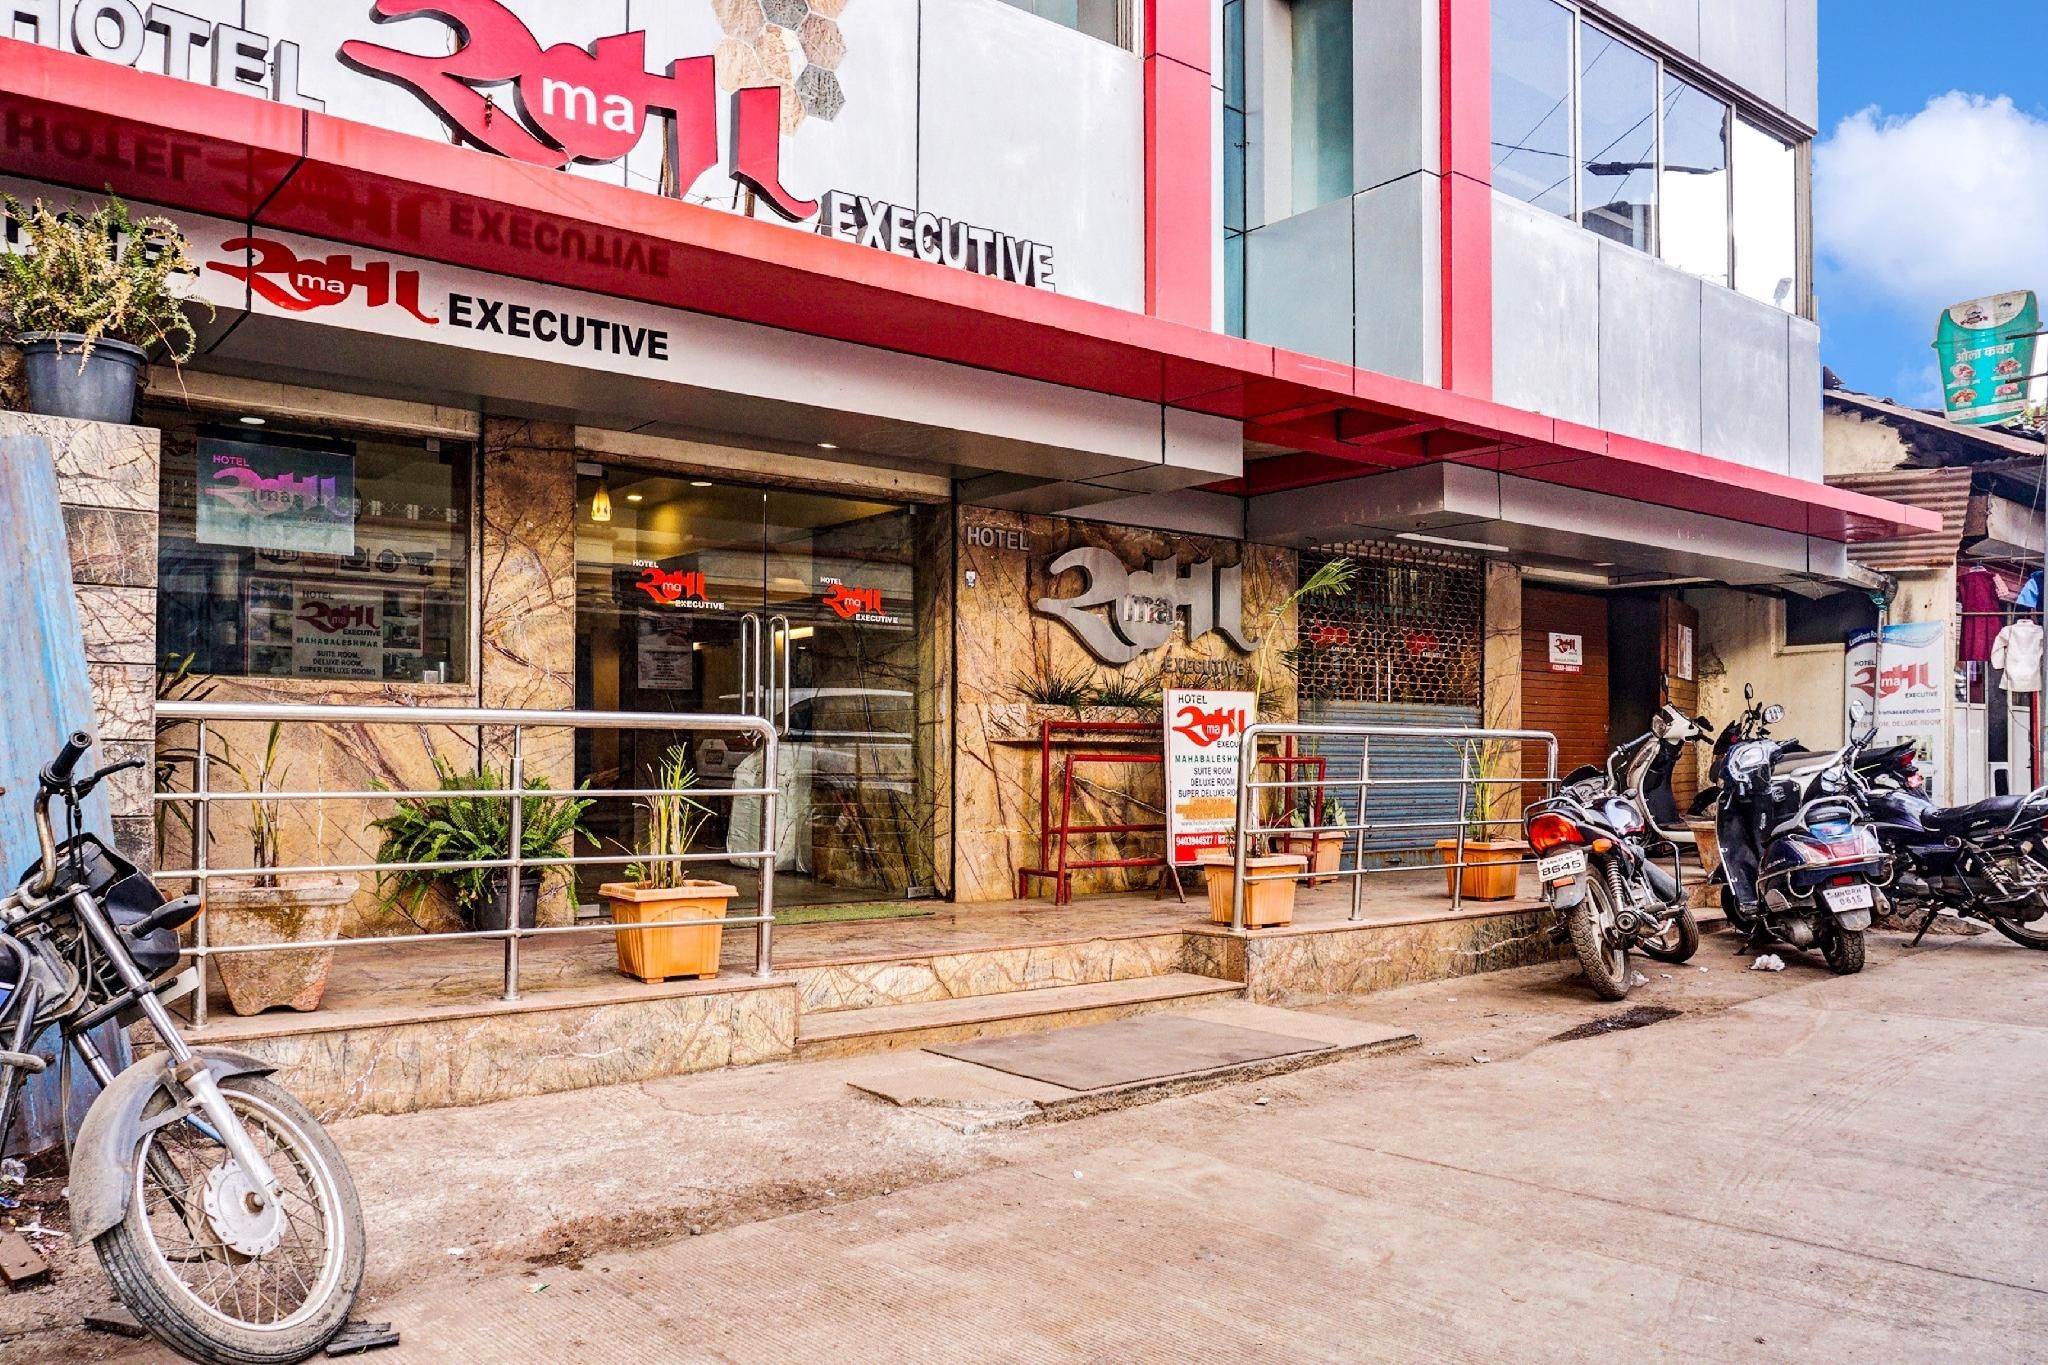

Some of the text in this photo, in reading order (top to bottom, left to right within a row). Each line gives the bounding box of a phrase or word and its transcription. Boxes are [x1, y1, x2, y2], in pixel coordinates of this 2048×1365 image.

[824, 190, 1056, 293] EXECUTIVE
[449, 293, 668, 360] EXECUTIVE
[212, 455, 250, 467] HOTEL
[966, 526, 1030, 551] HOTEL
[632, 559, 659, 569] HOTEL
[820, 576, 843, 586] HOTEL
[674, 599, 725, 611] EXECUTIVE
[855, 613, 899, 624] EXECUTIVE
[1178, 694, 1208, 705] HOTEL
[1905, 691, 1938, 699] EXECUTIVE
[1193, 767, 1211, 776] SUITE
[1190, 778, 1215, 787] DELUXE
[1178, 789, 1200, 798] SUPER
[1200, 788, 1225, 797] DELUXE
[1542, 860, 1581, 876] 8645
